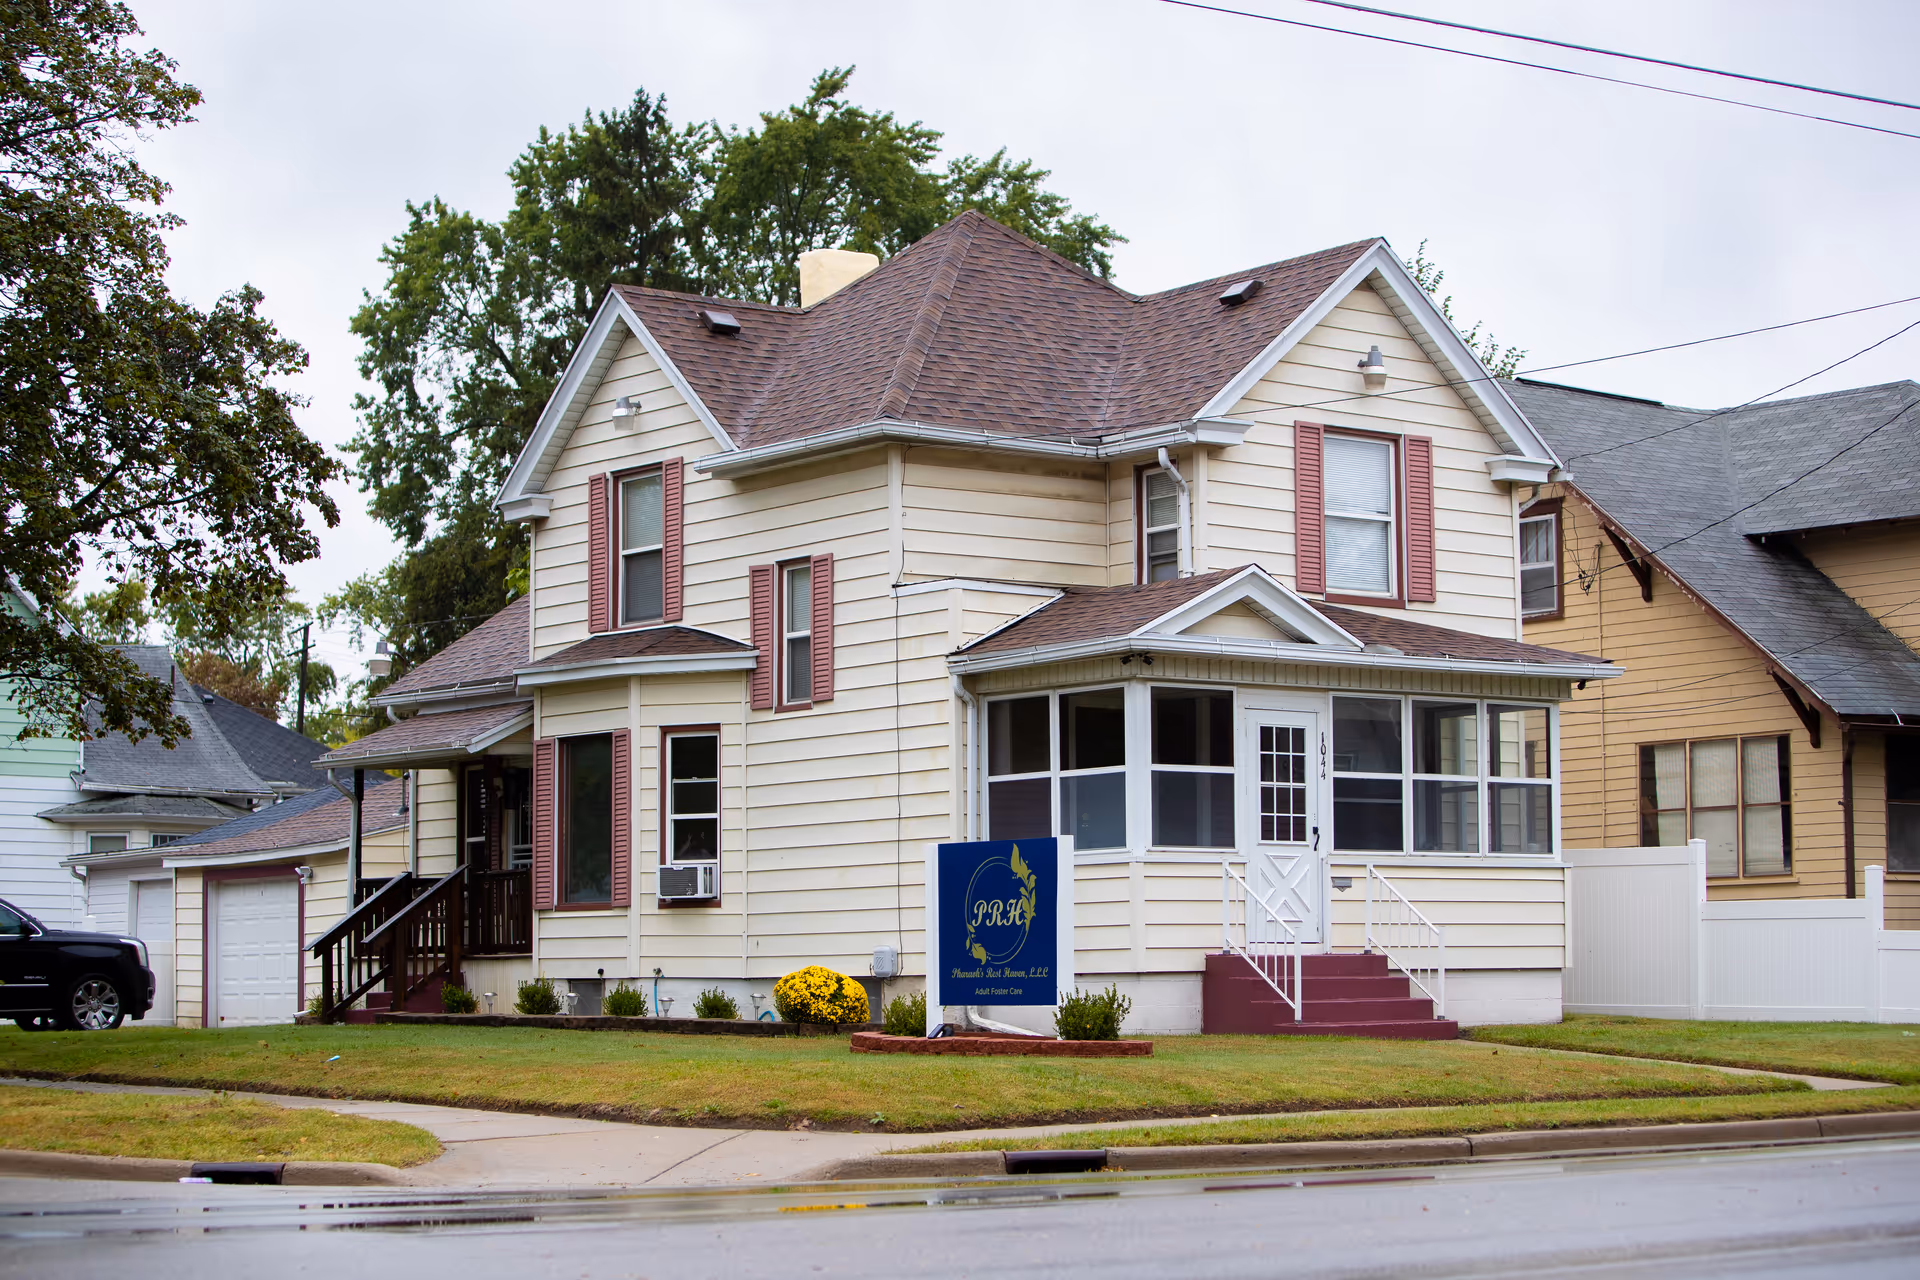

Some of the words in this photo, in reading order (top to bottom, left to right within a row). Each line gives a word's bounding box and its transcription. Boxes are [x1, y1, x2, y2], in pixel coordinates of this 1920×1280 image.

[972, 899, 1024, 926] PRH
[986, 967, 1001, 978] Rest
[1003, 967, 1027, 979] Haven,
[1010, 987, 1022, 995] Care
